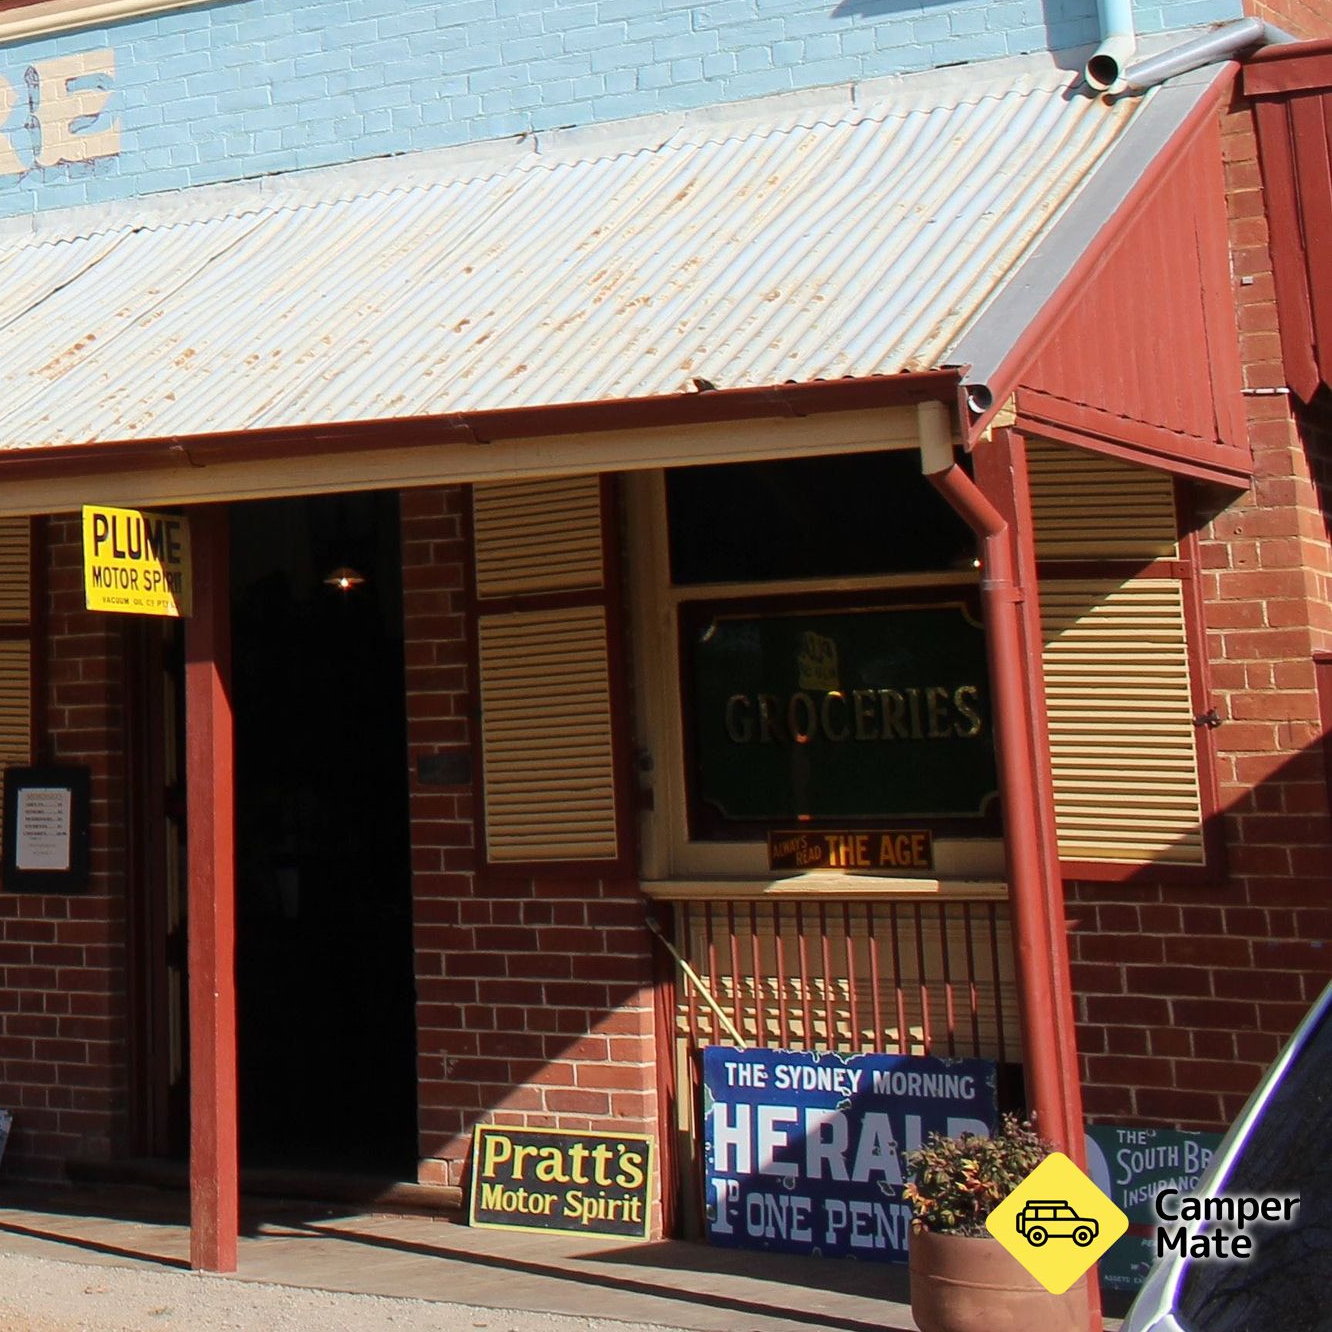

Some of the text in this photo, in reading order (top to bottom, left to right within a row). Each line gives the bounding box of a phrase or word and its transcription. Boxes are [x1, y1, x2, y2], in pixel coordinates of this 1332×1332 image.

[93, 513, 180, 564] PLUME
[92, 566, 139, 591] MOTOR
[724, 684, 982, 744] GROCERIES
[773, 834, 808, 860] ALWAYS
[796, 843, 822, 868] READ
[824, 833, 930, 867] THE AGE
[725, 1062, 976, 1100] THE SYDNEY MORNING
[1116, 1130, 1146, 1145] THE
[482, 1134, 644, 1189] Pratt's
[1116, 1146, 1178, 1186] SOUTH
[481, 1183, 641, 1225] Motor Spirit
[746, 1192, 813, 1243] ONE
